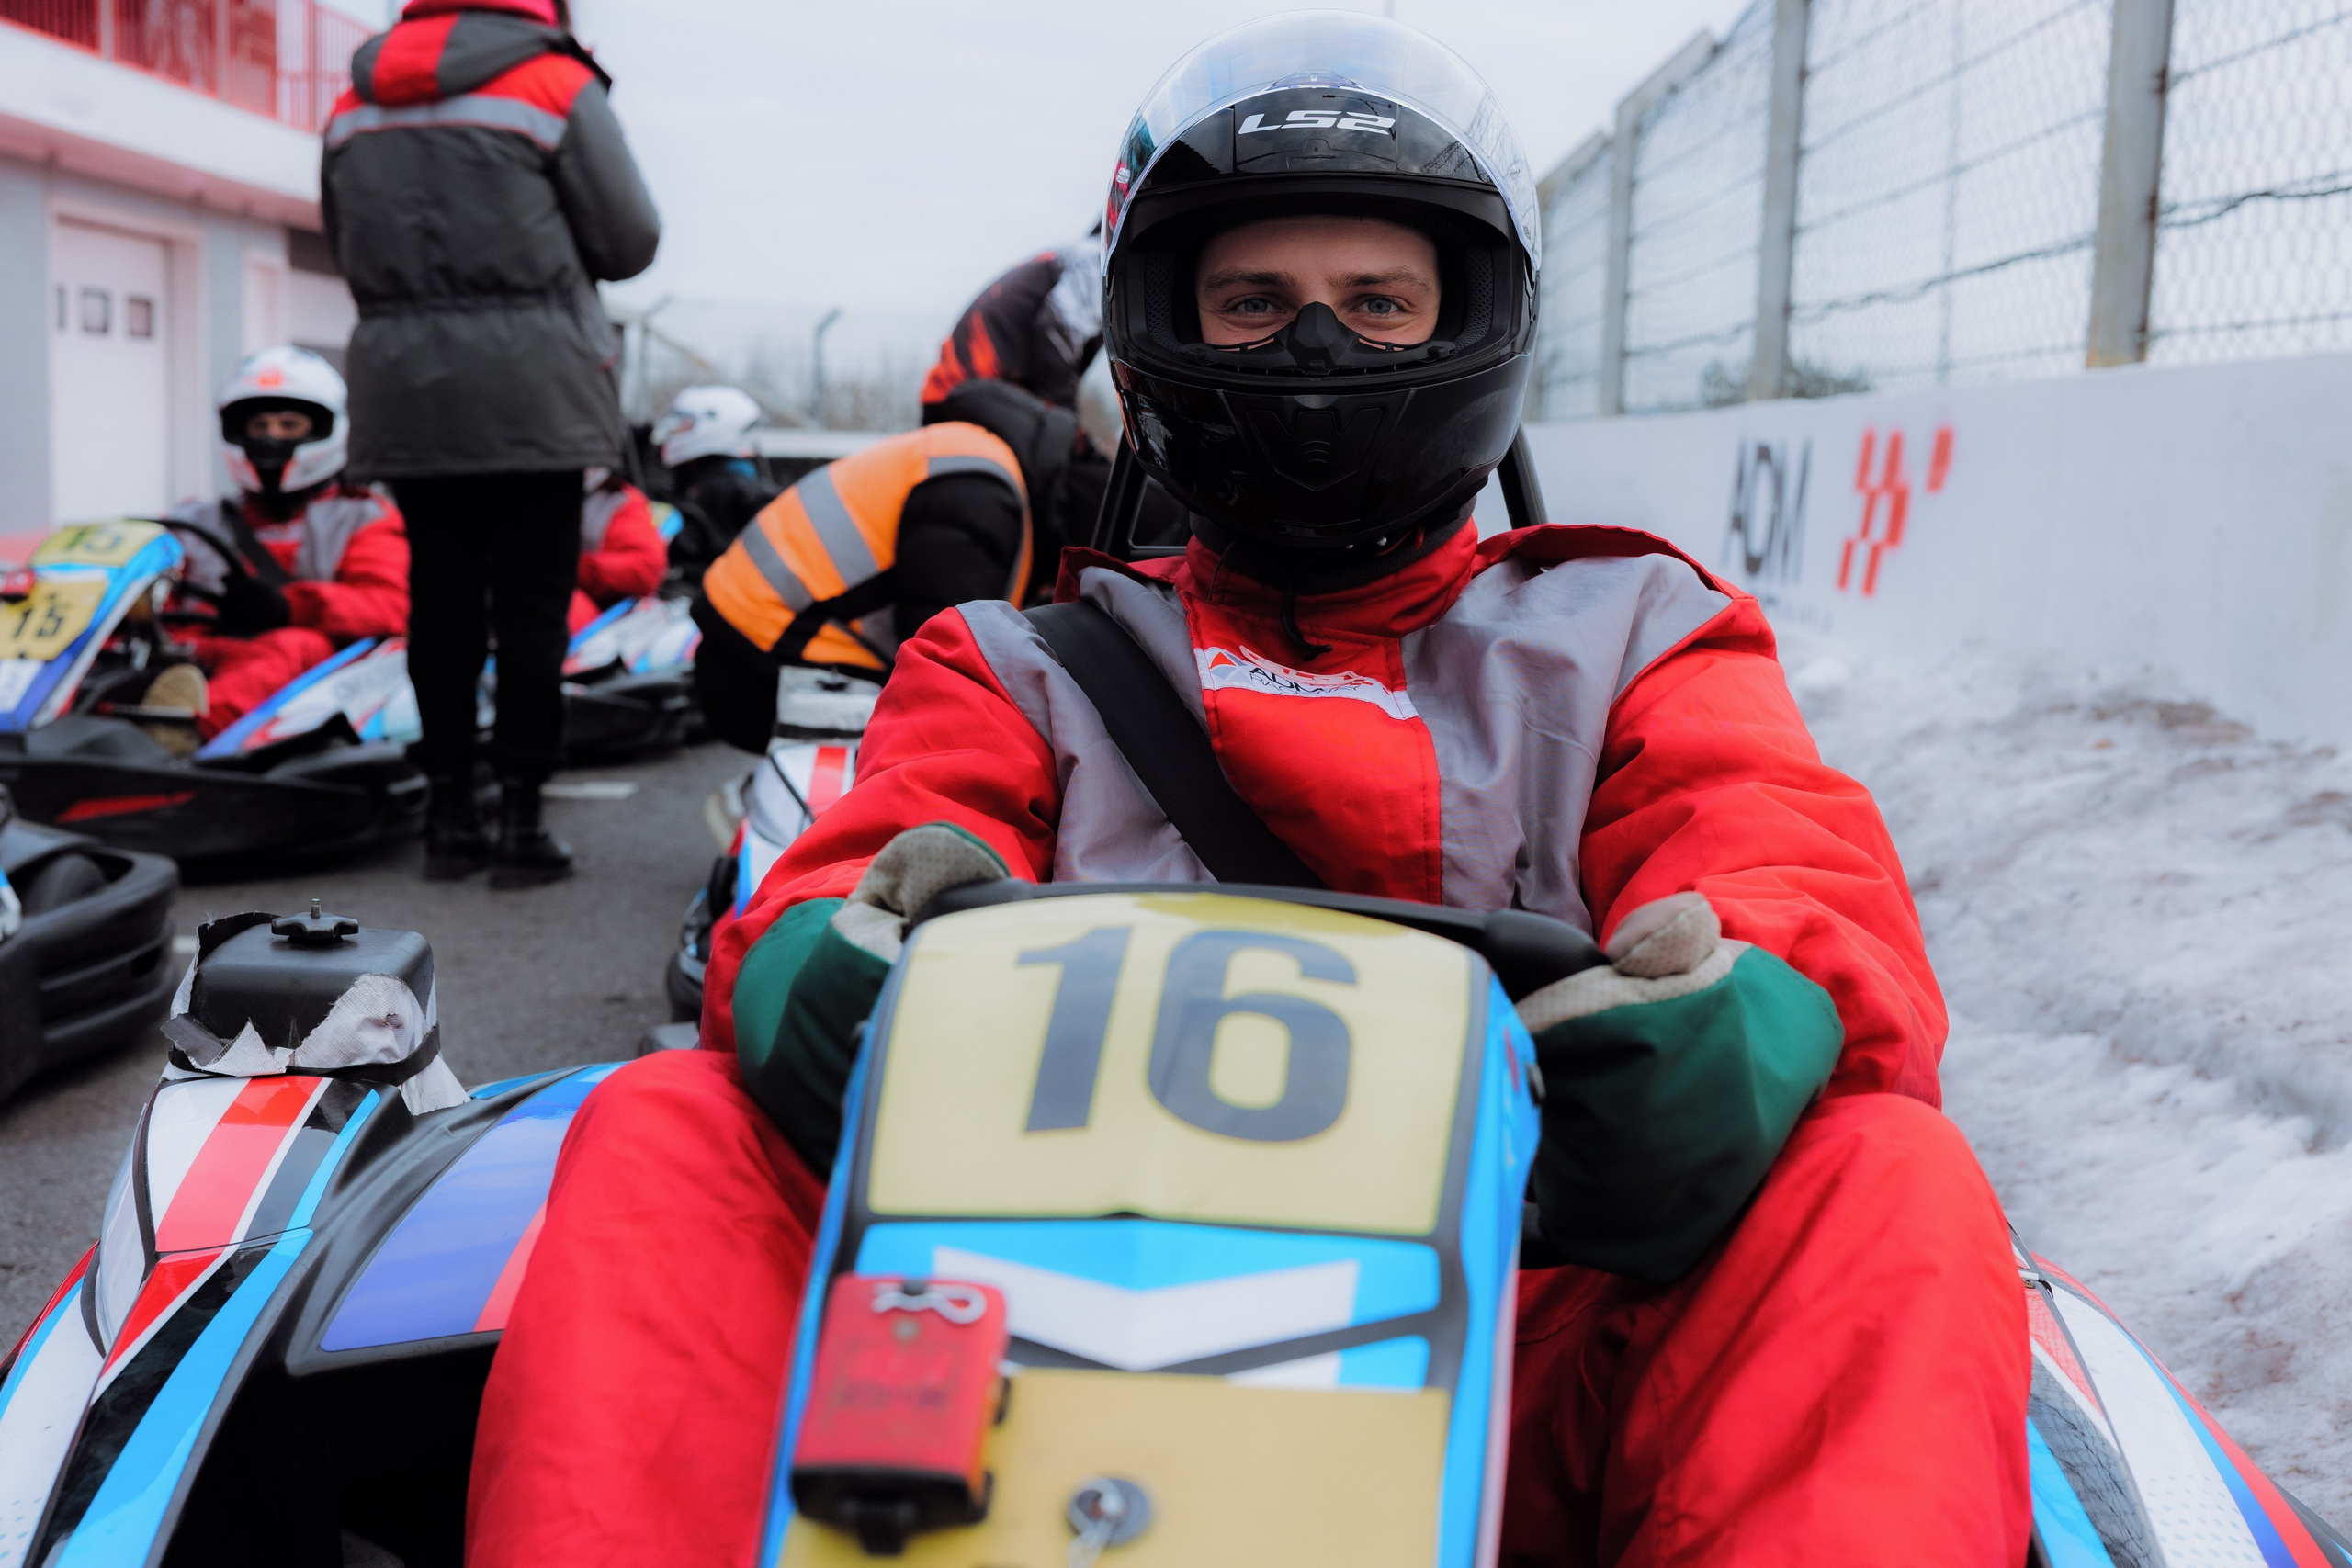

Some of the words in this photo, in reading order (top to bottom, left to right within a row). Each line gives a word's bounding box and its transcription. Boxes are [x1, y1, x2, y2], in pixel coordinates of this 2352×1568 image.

[1238, 110, 1396, 135] LS2
[15, 605, 64, 637] 15
[1015, 925, 1358, 1144] 16
